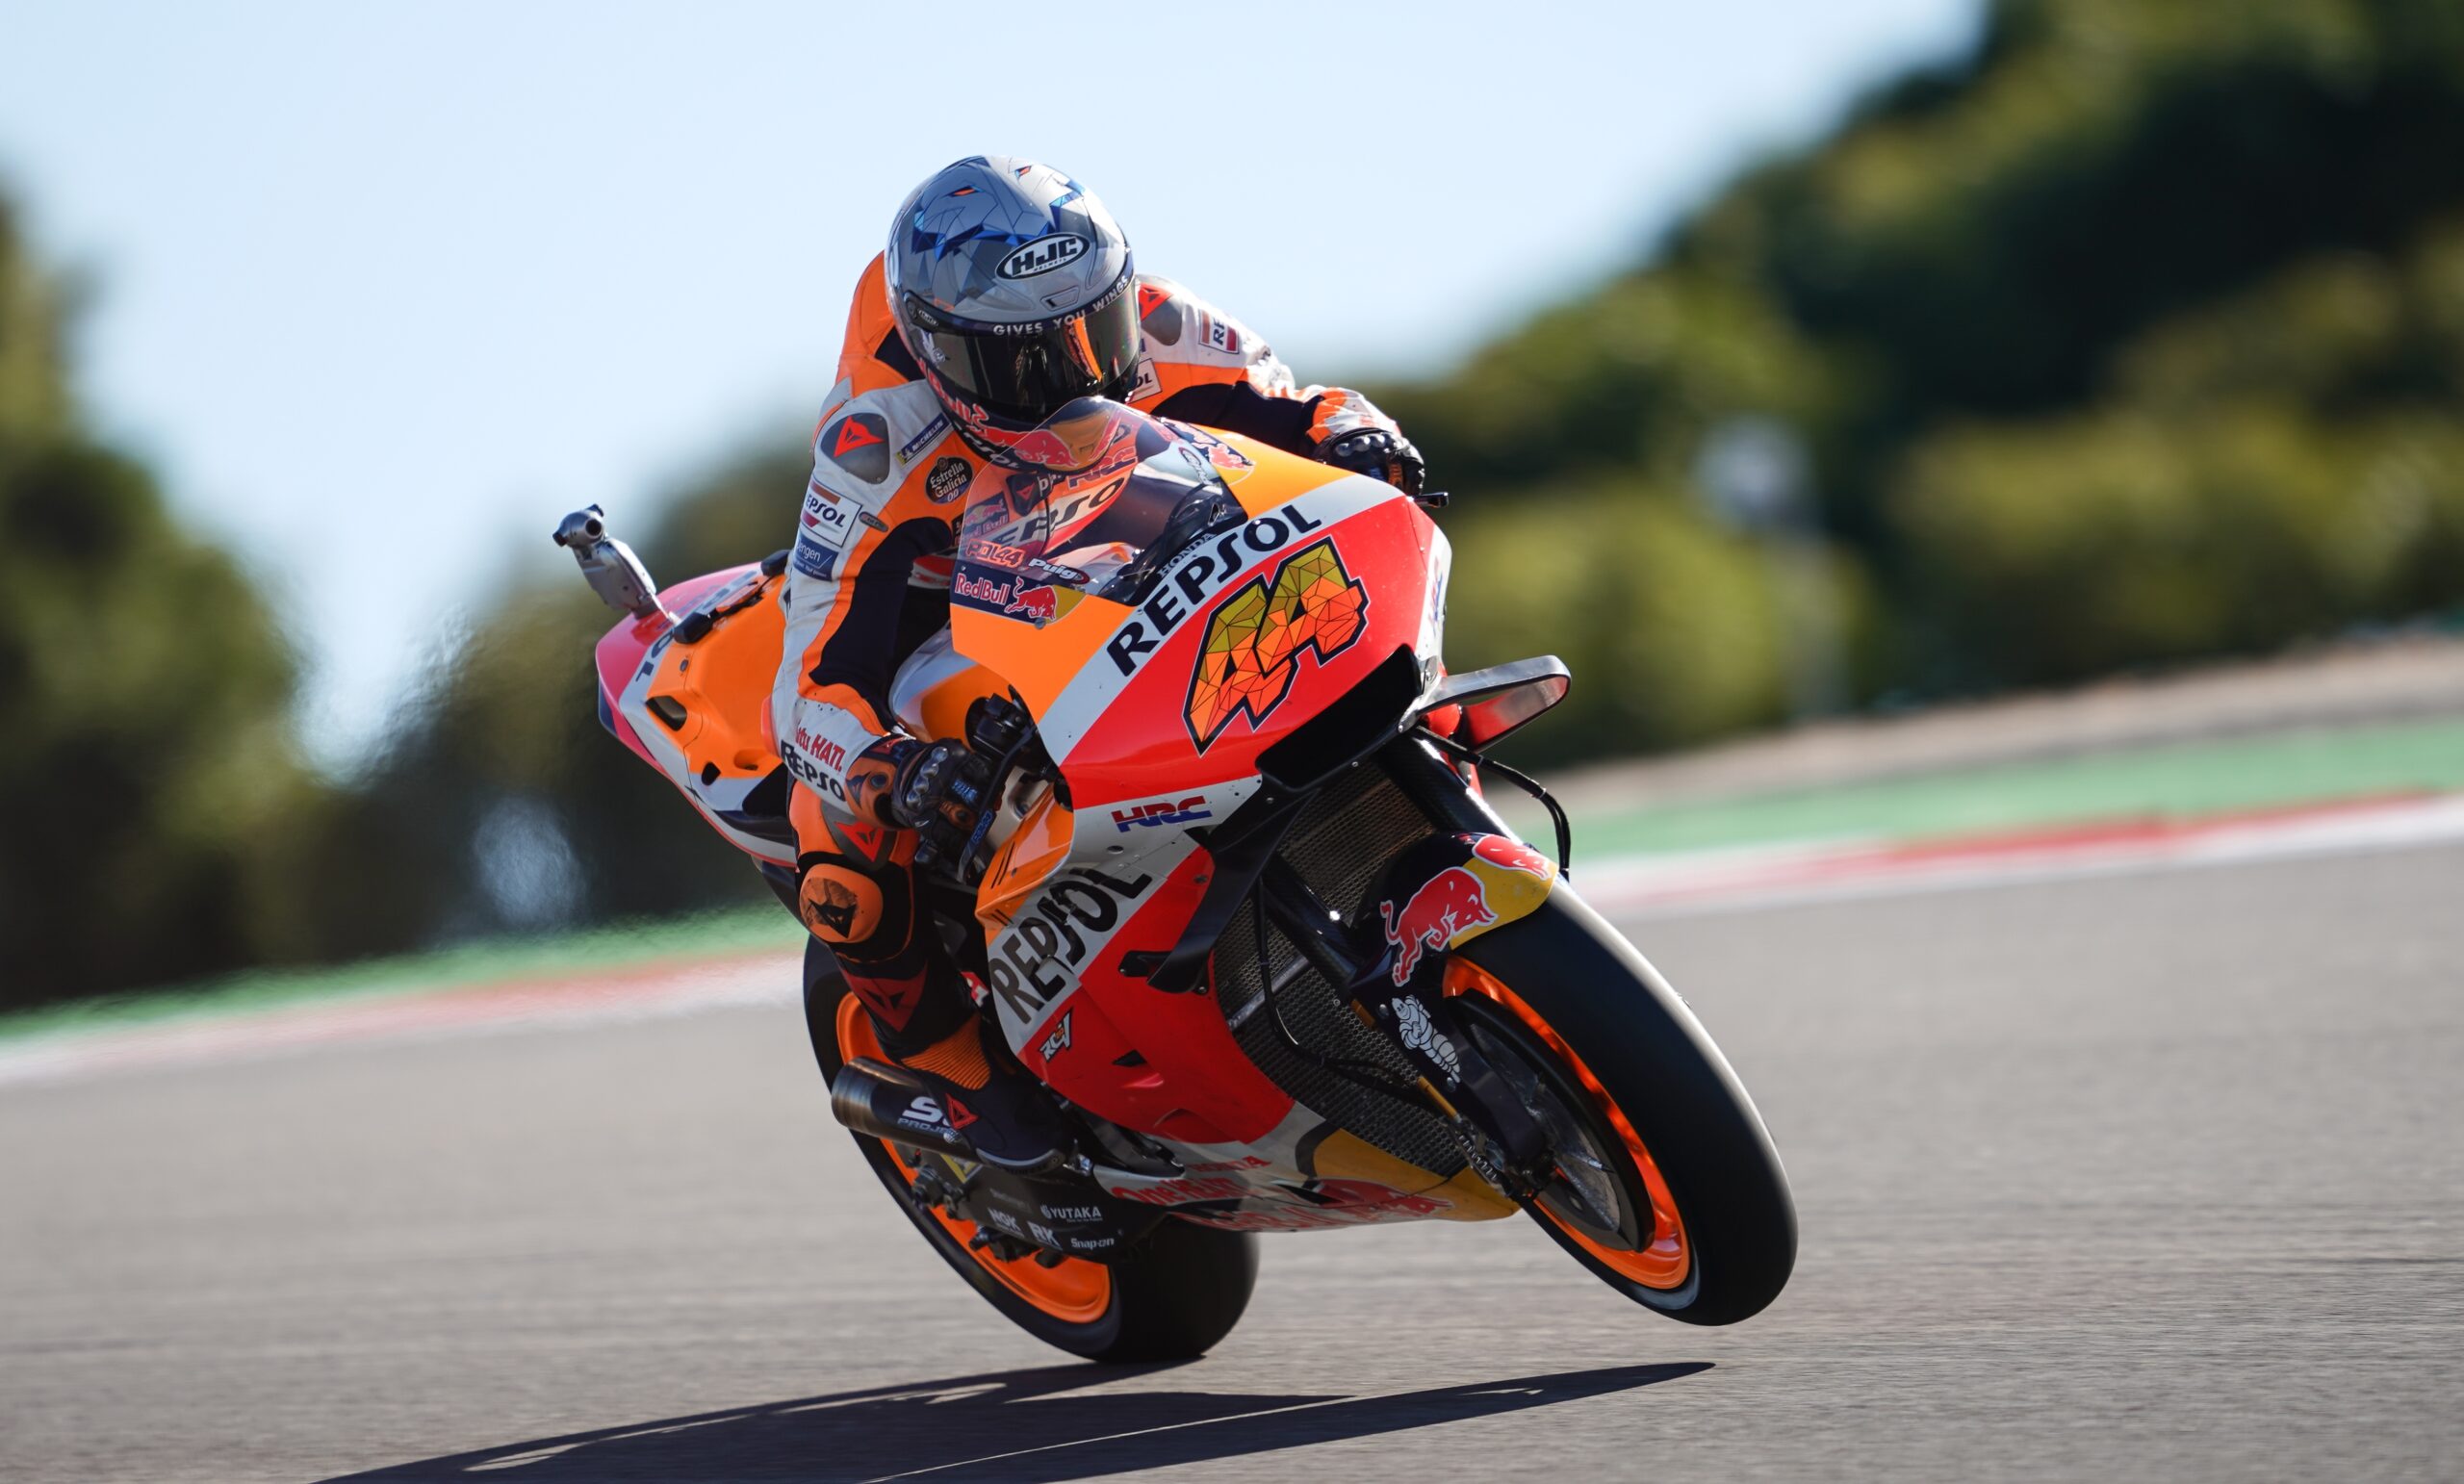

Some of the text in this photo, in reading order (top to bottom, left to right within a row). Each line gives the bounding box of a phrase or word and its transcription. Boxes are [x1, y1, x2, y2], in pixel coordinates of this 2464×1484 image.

[1012, 237, 1078, 277] HJC
[993, 275, 1128, 336] GIVES YOU WINGS
[911, 420, 943, 451] MICHELIN
[930, 462, 964, 488] Estrella
[935, 473, 967, 498] Galicia
[1028, 558, 1079, 580] Puig
[1157, 532, 1218, 577] HONDA
[955, 573, 983, 599] Red
[980, 578, 1011, 605] Bull
[1107, 504, 1322, 677] REPSOL
[1182, 535, 1371, 757] 44
[1111, 795, 1213, 832] HRC
[988, 868, 1153, 1024] REPSOL
[902, 1096, 951, 1127] S
[988, 1207, 1022, 1233] NGK
[1050, 1206, 1102, 1219] YUTAKA
[1027, 1220, 1064, 1251] RK
[1070, 1238, 1115, 1250] Snap-on
